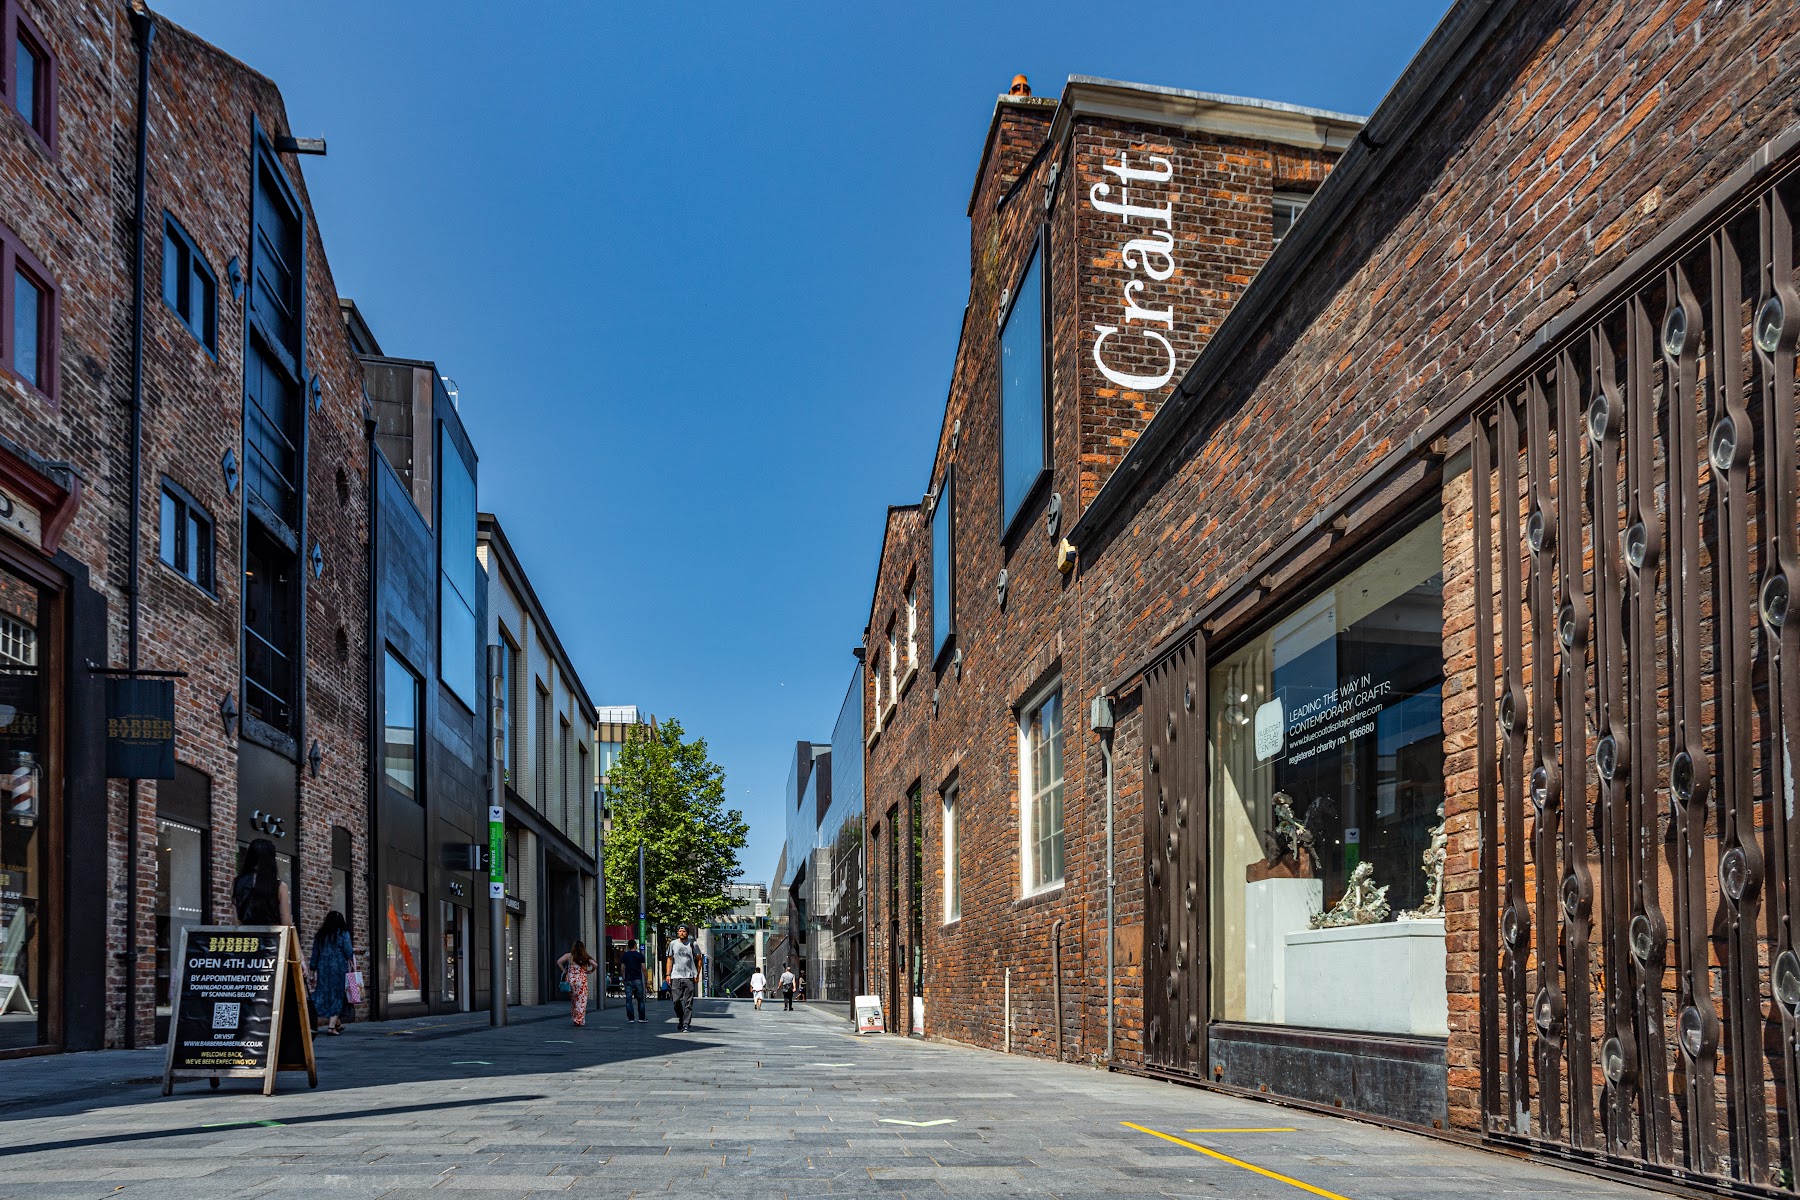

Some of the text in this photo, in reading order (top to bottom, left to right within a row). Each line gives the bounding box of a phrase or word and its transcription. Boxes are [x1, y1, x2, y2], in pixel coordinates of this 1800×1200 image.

[1089, 151, 1177, 390] Craft
[1289, 673, 1371, 723] LEADING THE WAY IN
[1289, 680, 1391, 737] CONTEMPORARY CRAFTS
[1258, 730, 1279, 746] DISPLAY
[1289, 703, 1383, 749] www.bluecoatdisplaycentre.com
[1258, 741, 1279, 755] CENTRE
[1288, 721, 1375, 765] registered charity no. 1136680
[251, 809, 286, 838] COS
[189, 958, 276, 969] OPEN 4TH JULY
[190, 974, 271, 982] BY APPOINTMENT ONLY
[244, 1058, 257, 1066] YOU
